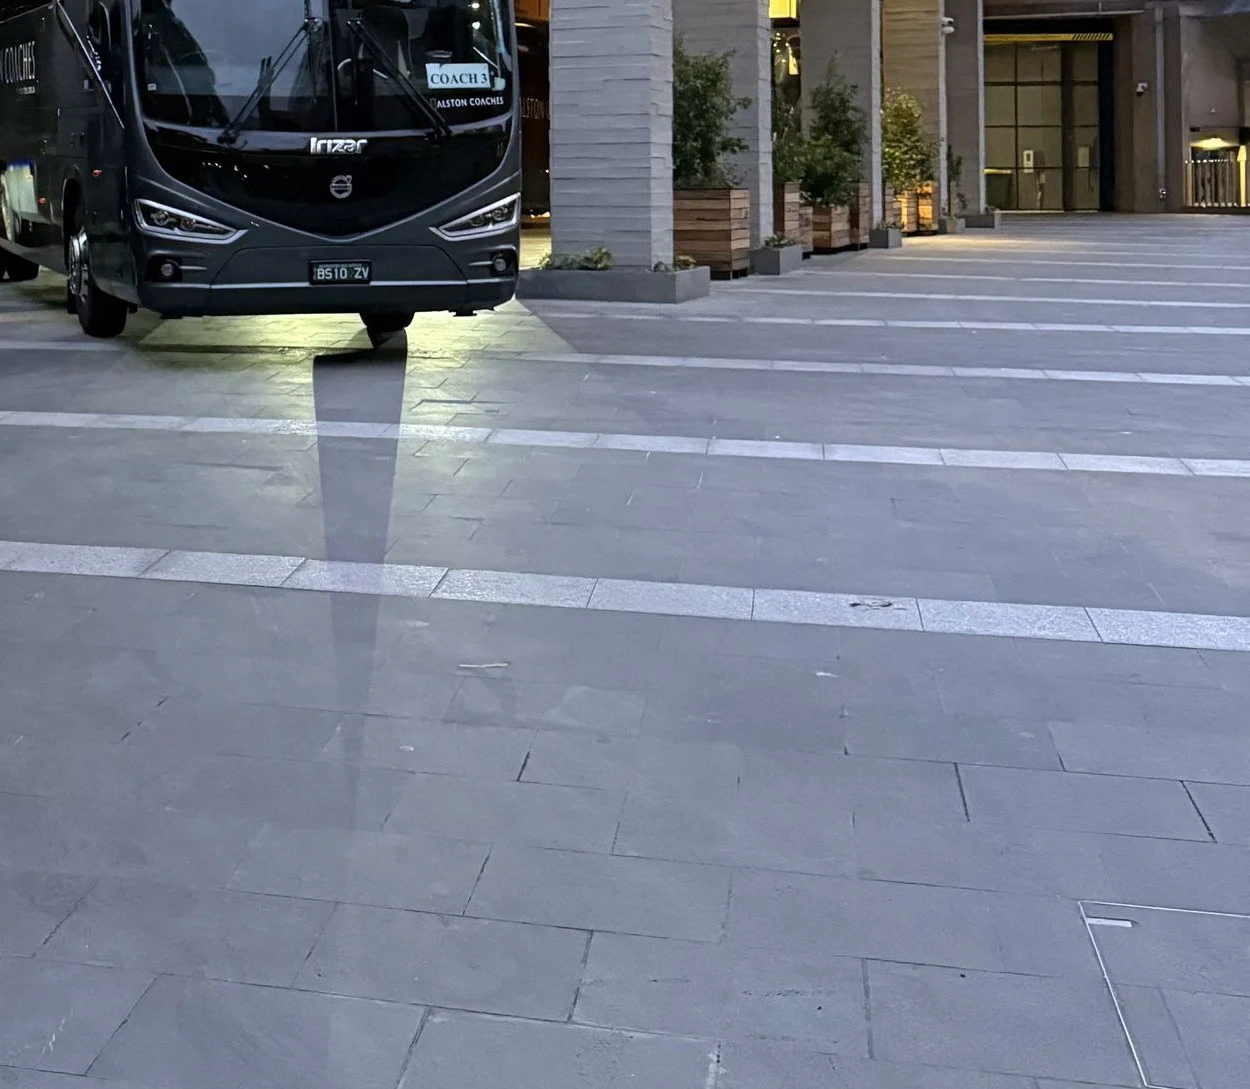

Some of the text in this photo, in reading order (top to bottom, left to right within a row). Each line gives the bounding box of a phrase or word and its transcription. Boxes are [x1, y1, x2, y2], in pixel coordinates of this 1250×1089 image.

[430, 73, 488, 85] COACH 3
[437, 96, 504, 108] ALSTON COACHES
[310, 137, 368, 154] Irizar
[317, 267, 348, 280] BS10
[353, 266, 369, 279] ZV
